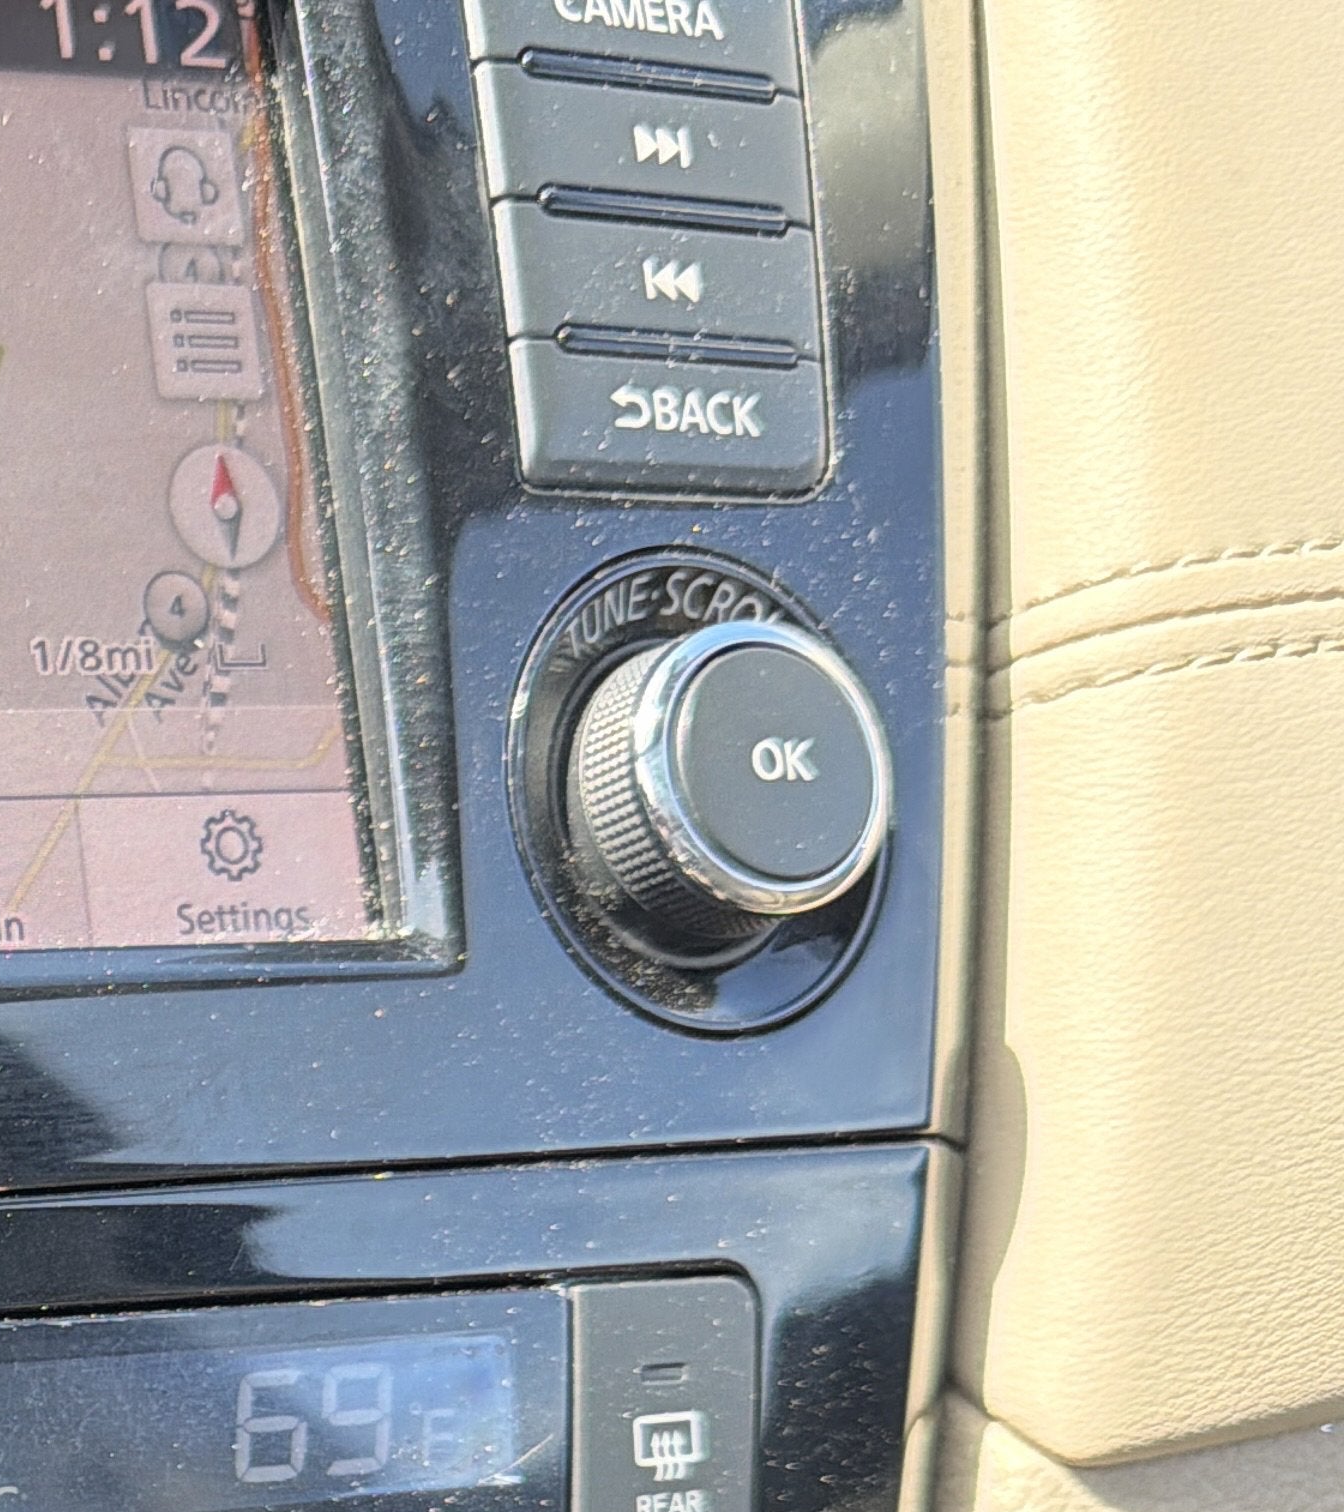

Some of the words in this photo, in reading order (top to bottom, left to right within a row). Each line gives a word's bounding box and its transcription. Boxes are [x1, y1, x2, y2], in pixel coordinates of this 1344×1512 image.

[554, 0, 725, 41] CAMERA
[651, 388, 764, 437] BACK
[32, 638, 155, 674] 1/8mi
[752, 738, 820, 782] OK
[177, 904, 311, 935] Settings
